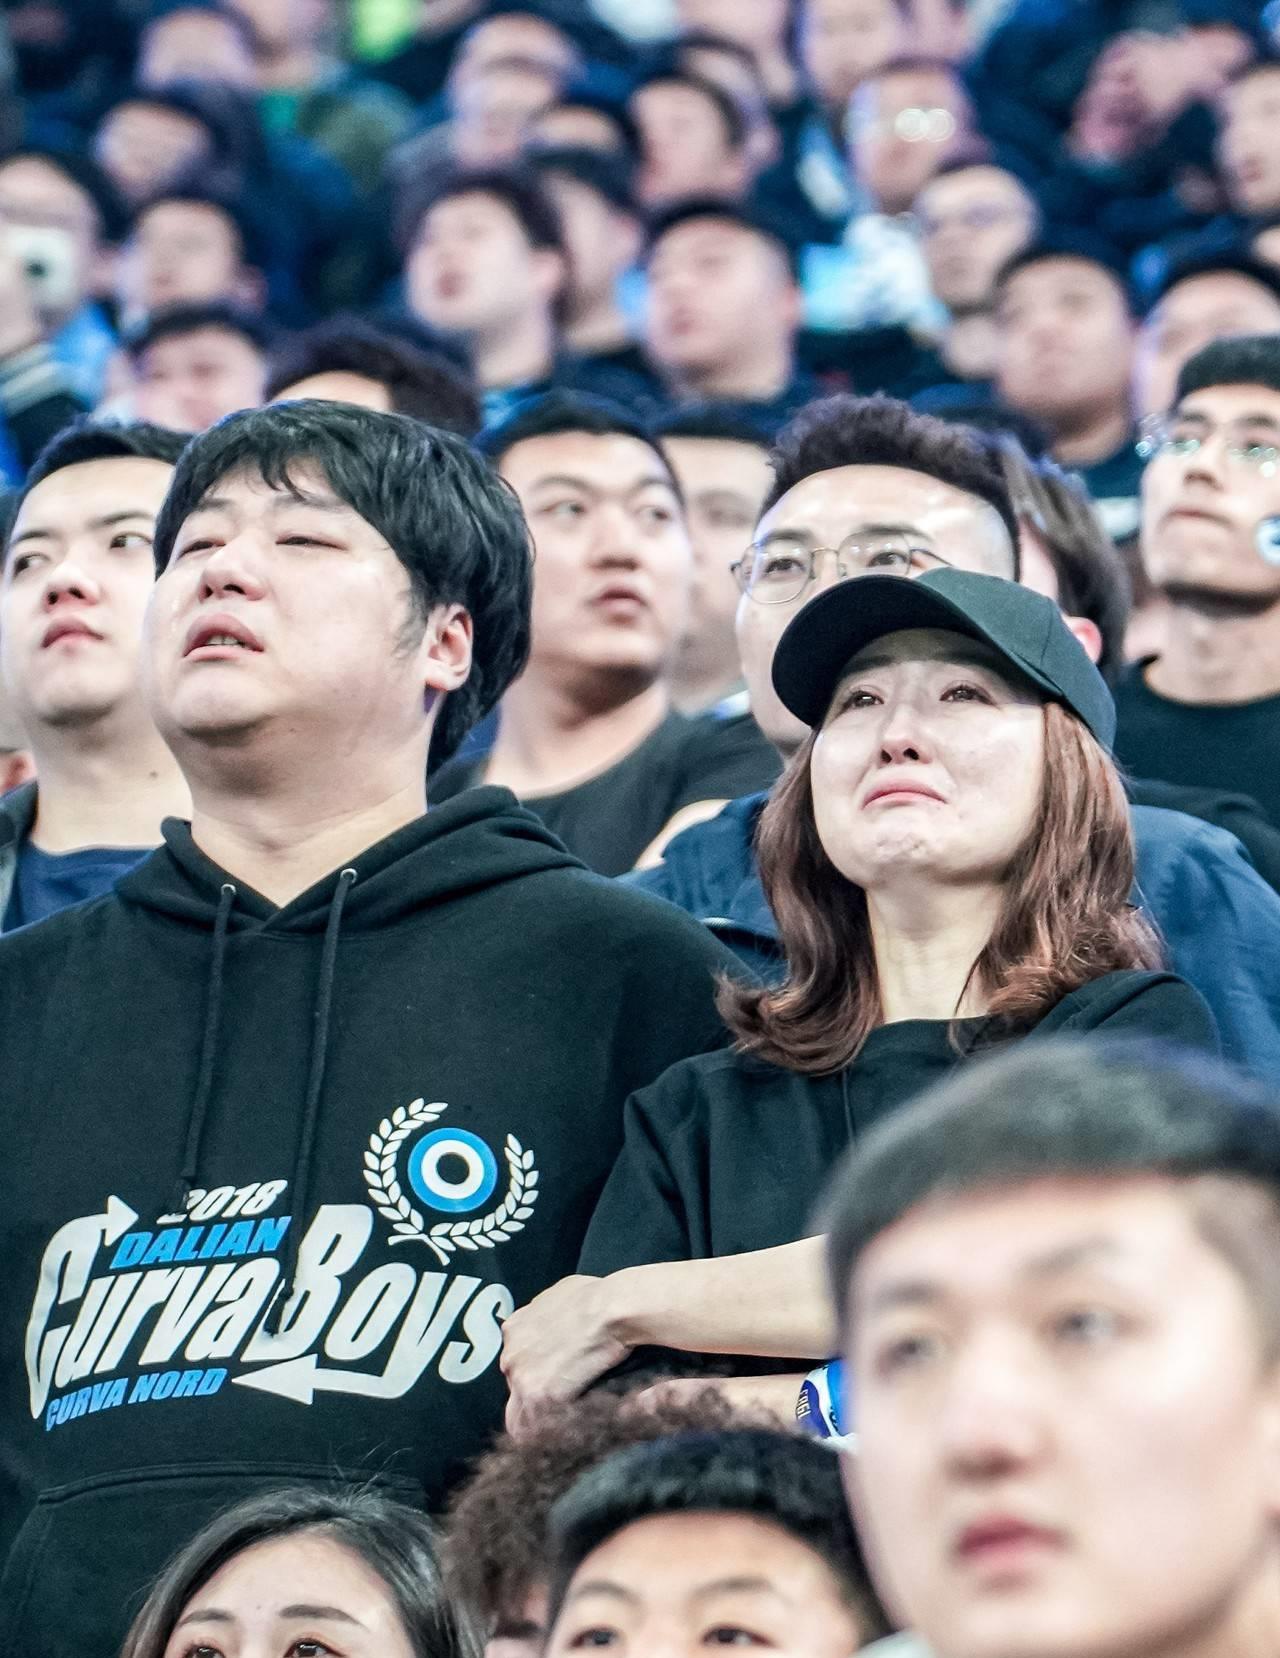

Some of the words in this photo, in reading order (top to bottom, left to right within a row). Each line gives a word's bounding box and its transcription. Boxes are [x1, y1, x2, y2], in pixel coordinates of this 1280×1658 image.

[156, 1180, 288, 1224] 2018
[109, 1215, 292, 1269] DALIAN
[46, 1378, 129, 1431] CURVA
[128, 1368, 228, 1403] NORD
